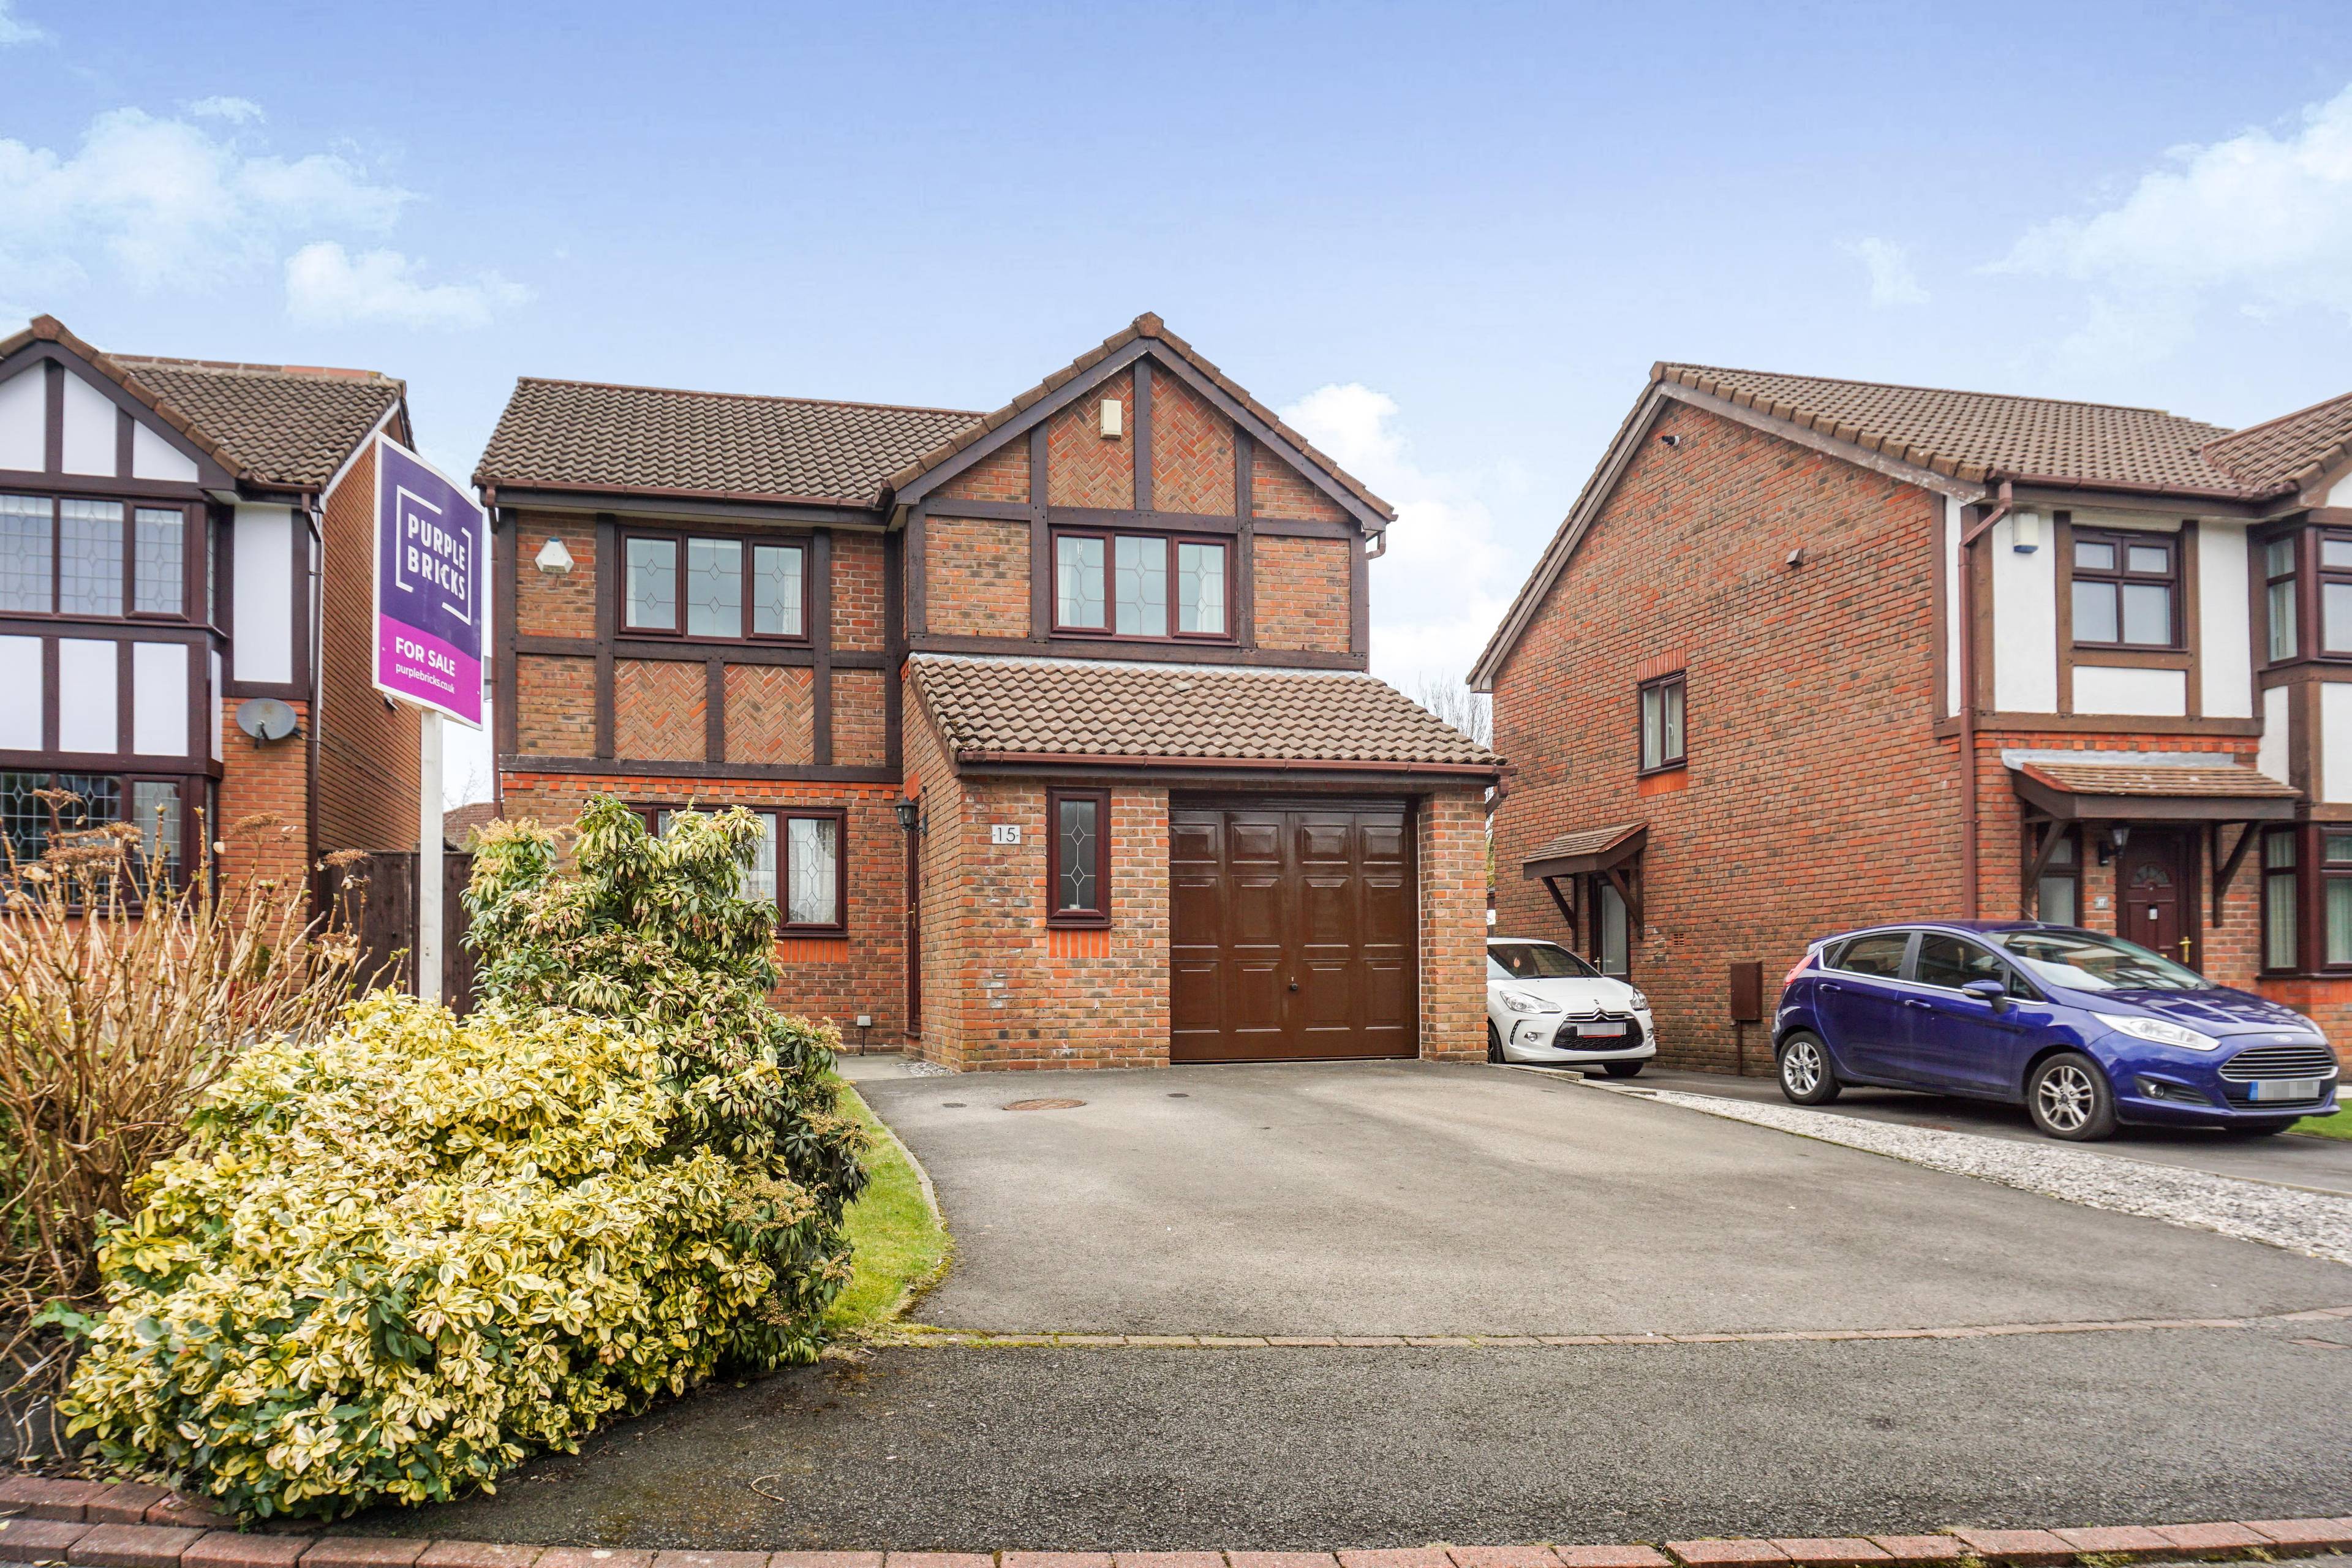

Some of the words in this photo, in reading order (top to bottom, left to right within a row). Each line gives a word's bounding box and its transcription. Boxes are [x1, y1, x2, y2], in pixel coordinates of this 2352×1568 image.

[408, 513, 466, 571] PURPLE
[407, 545, 466, 600] BRICKS
[396, 636, 425, 663] FOR
[428, 649, 456, 677] SALE
[396, 663, 455, 694] purplebricks.co.uk
[998, 827, 1016, 842] 15
